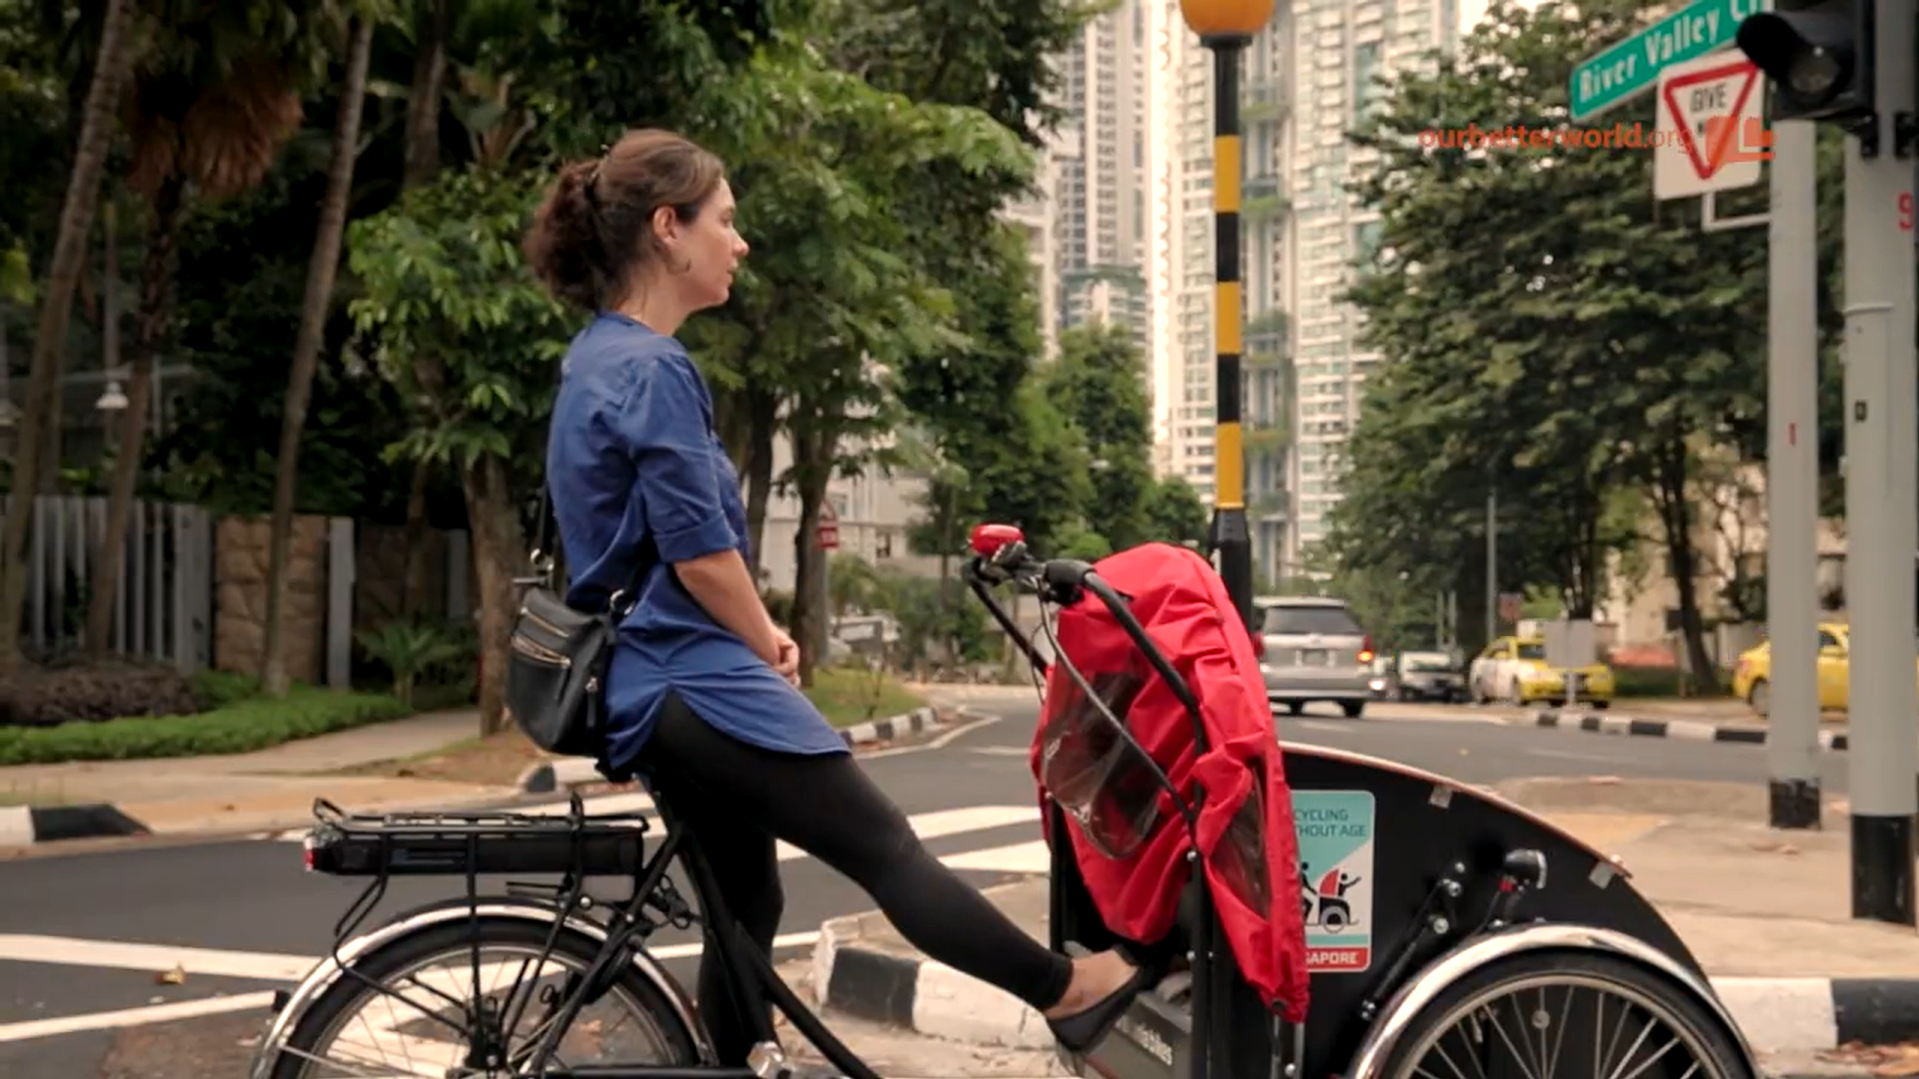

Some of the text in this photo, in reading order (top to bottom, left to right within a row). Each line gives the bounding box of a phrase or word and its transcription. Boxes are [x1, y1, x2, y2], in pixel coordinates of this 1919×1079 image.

[1580, 54, 1637, 103] River
[1645, 8, 1721, 66] Valley
[1690, 82, 1727, 113] GIVE
[1294, 808, 1349, 821] CYCLING
[1296, 824, 1366, 837] HOUT AGE
